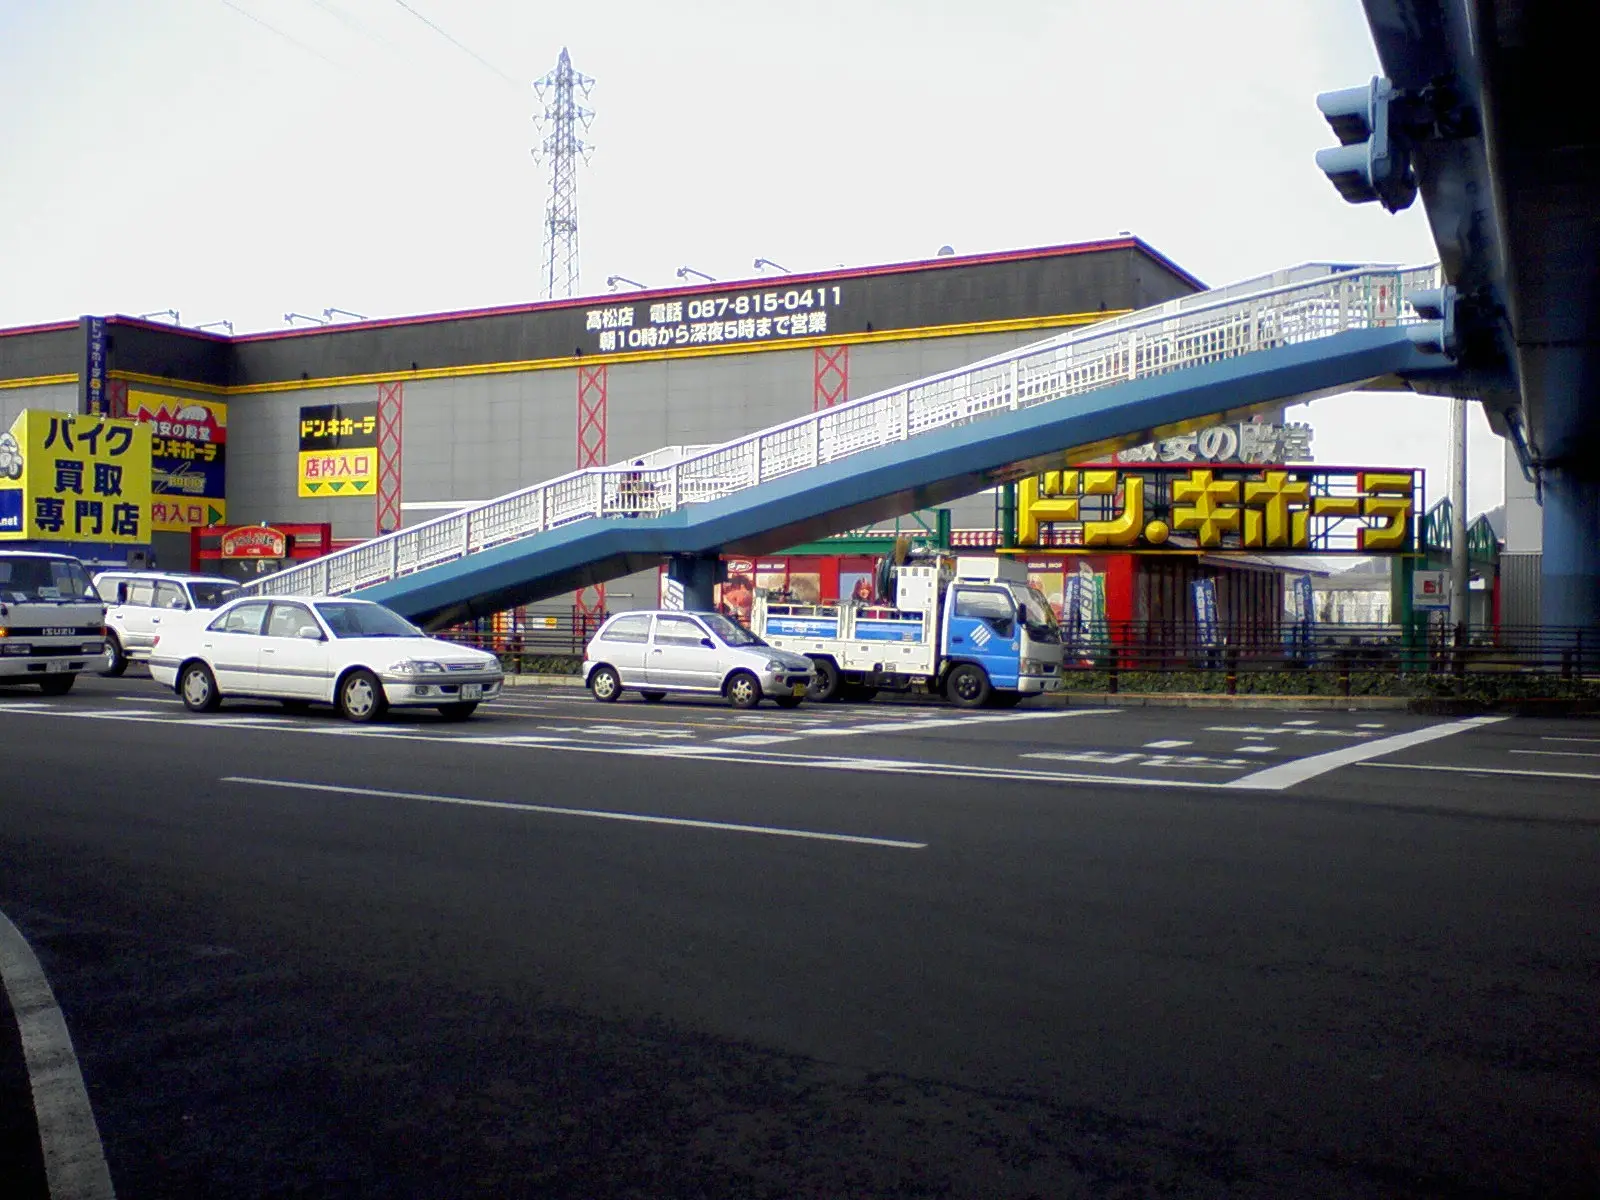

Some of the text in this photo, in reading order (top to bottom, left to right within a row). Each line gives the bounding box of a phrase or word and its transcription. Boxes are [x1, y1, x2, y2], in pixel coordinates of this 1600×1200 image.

[650, 302, 682, 323] 電話
[688, 286, 842, 319] 087-815-0411
[599, 312, 828, 351] 朝10時から深夜5時まで営業
[44, 418, 133, 456] バイク
[151, 419, 211, 441] 安の殿堂
[54, 459, 123, 497] 買取
[306, 456, 369, 477] 店内入口
[34, 497, 140, 537] 専門店
